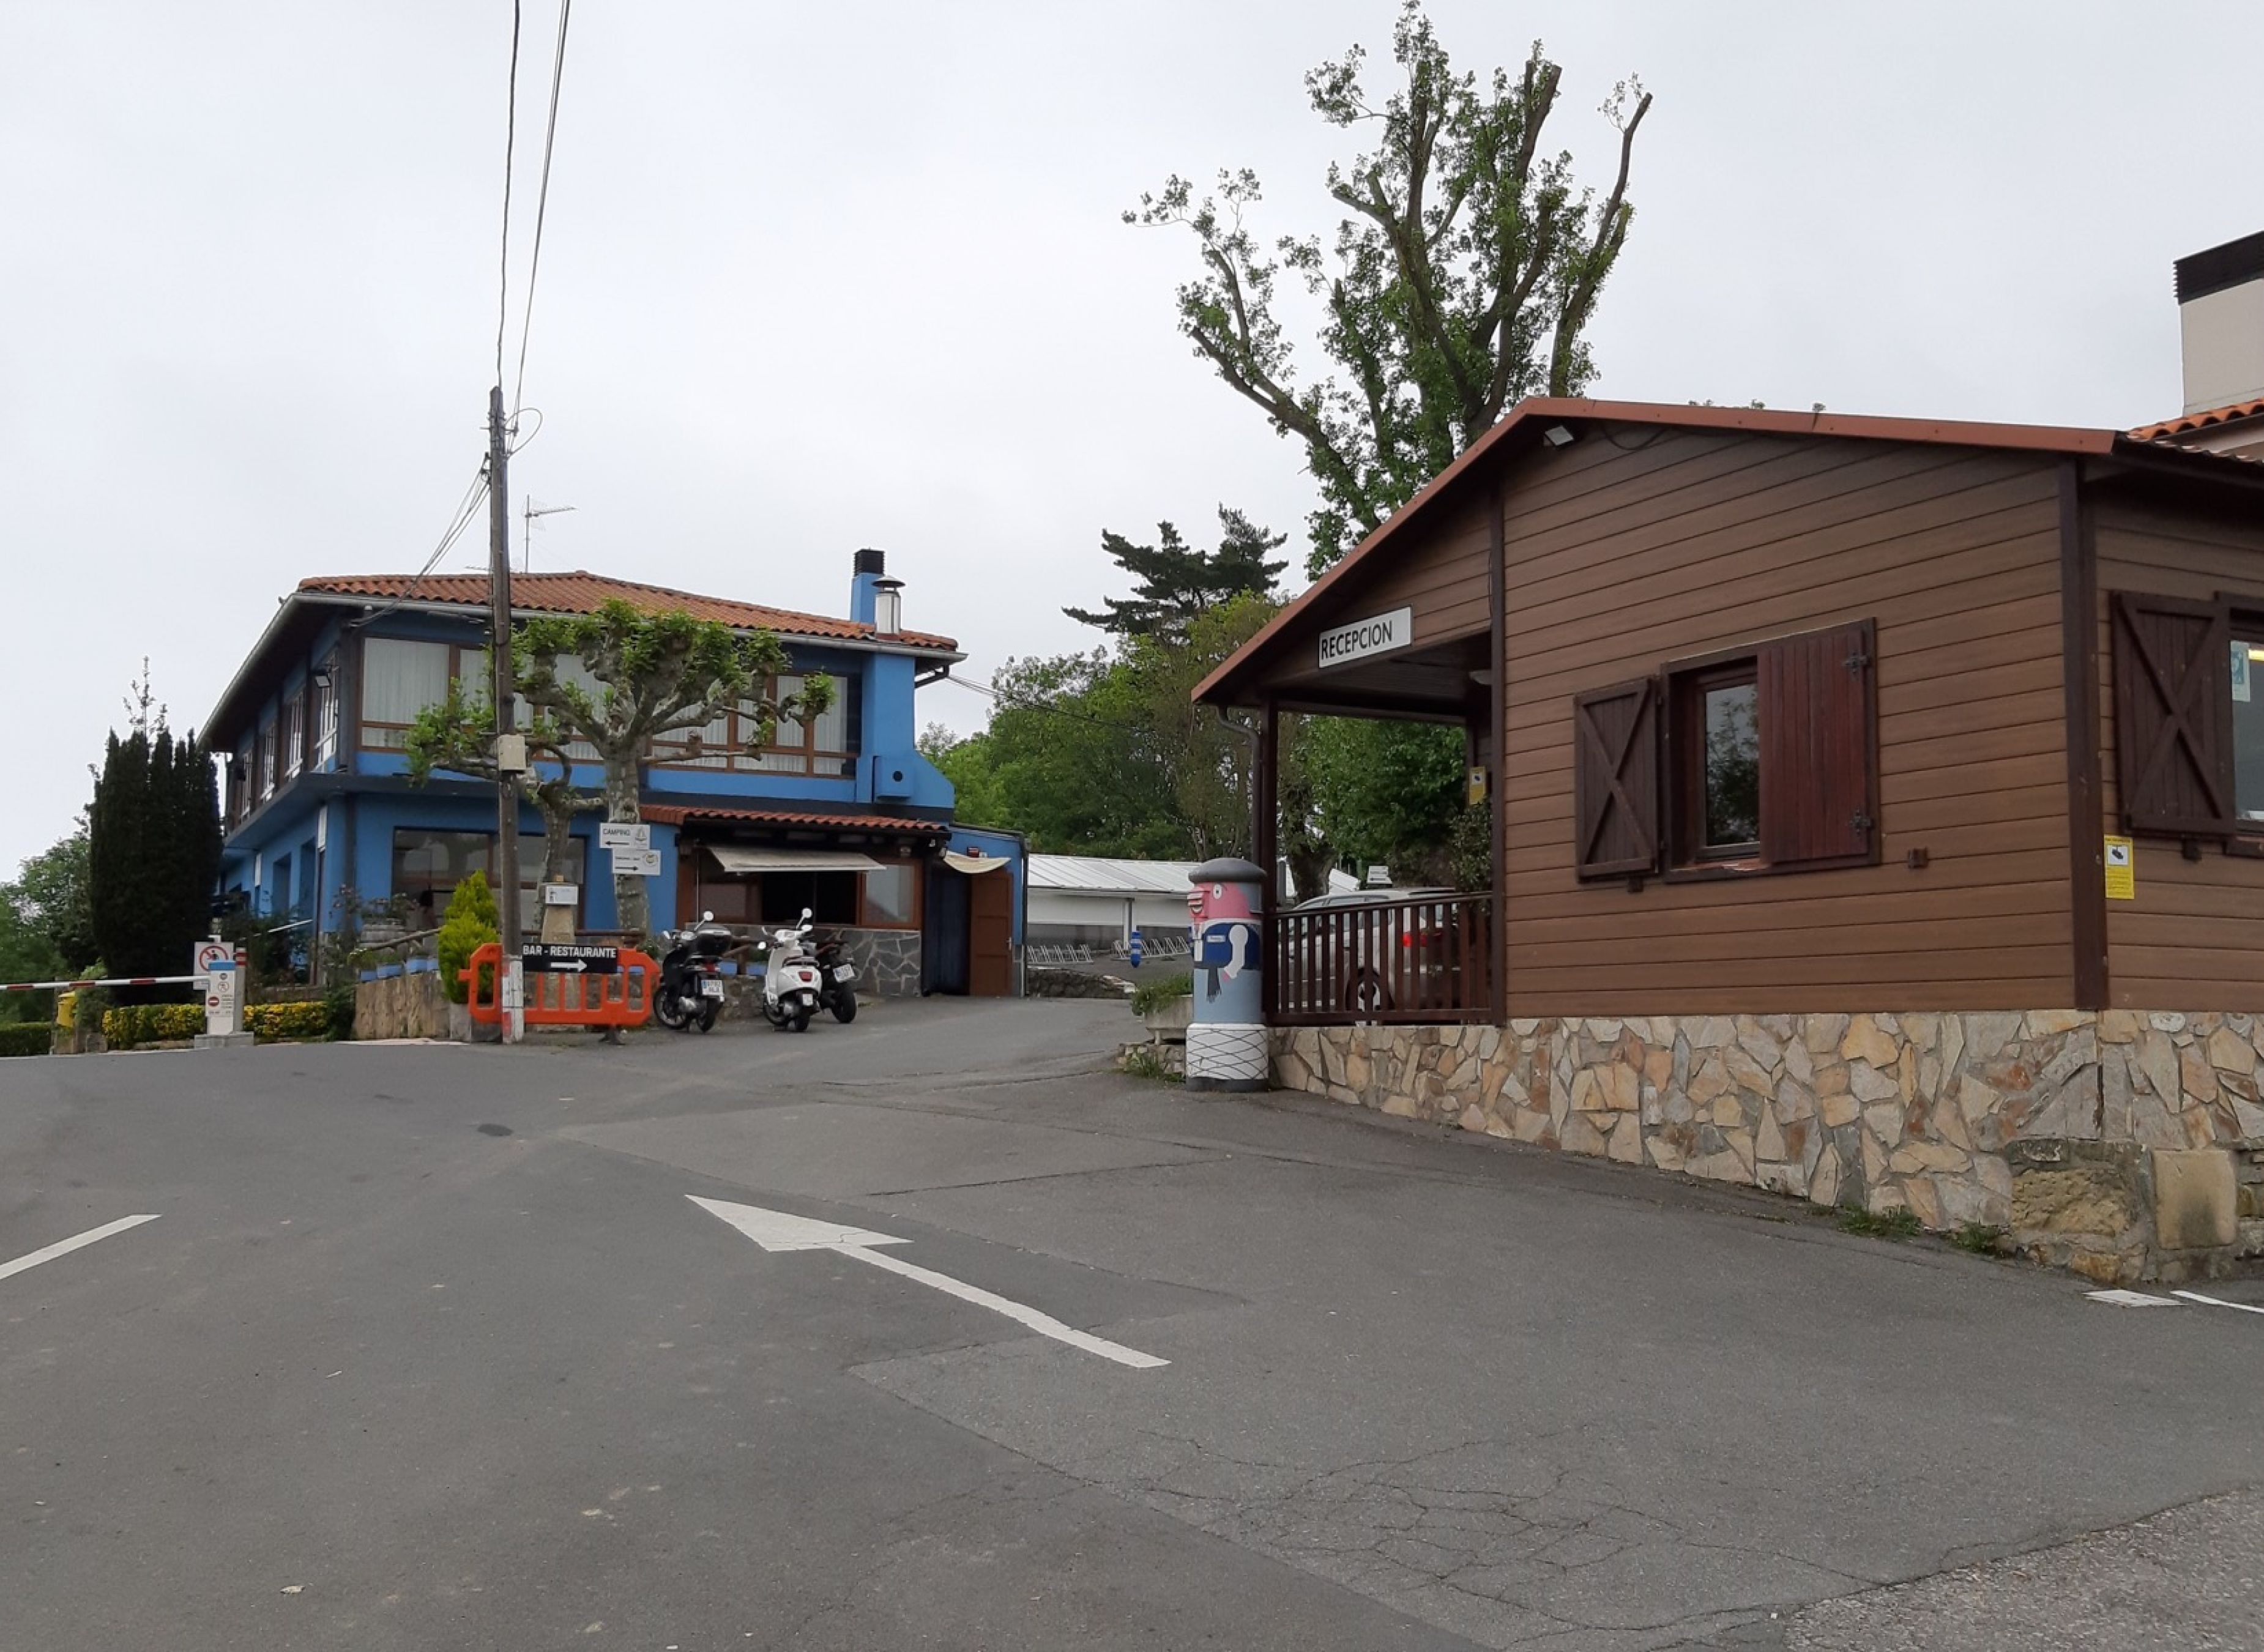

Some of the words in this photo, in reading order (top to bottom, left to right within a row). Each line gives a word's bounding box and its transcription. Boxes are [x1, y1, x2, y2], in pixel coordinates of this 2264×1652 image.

[1322, 620, 1392, 660] RECEPCION
[523, 945, 542, 955] BAR
[550, 945, 616, 958] RESTAURANTE
